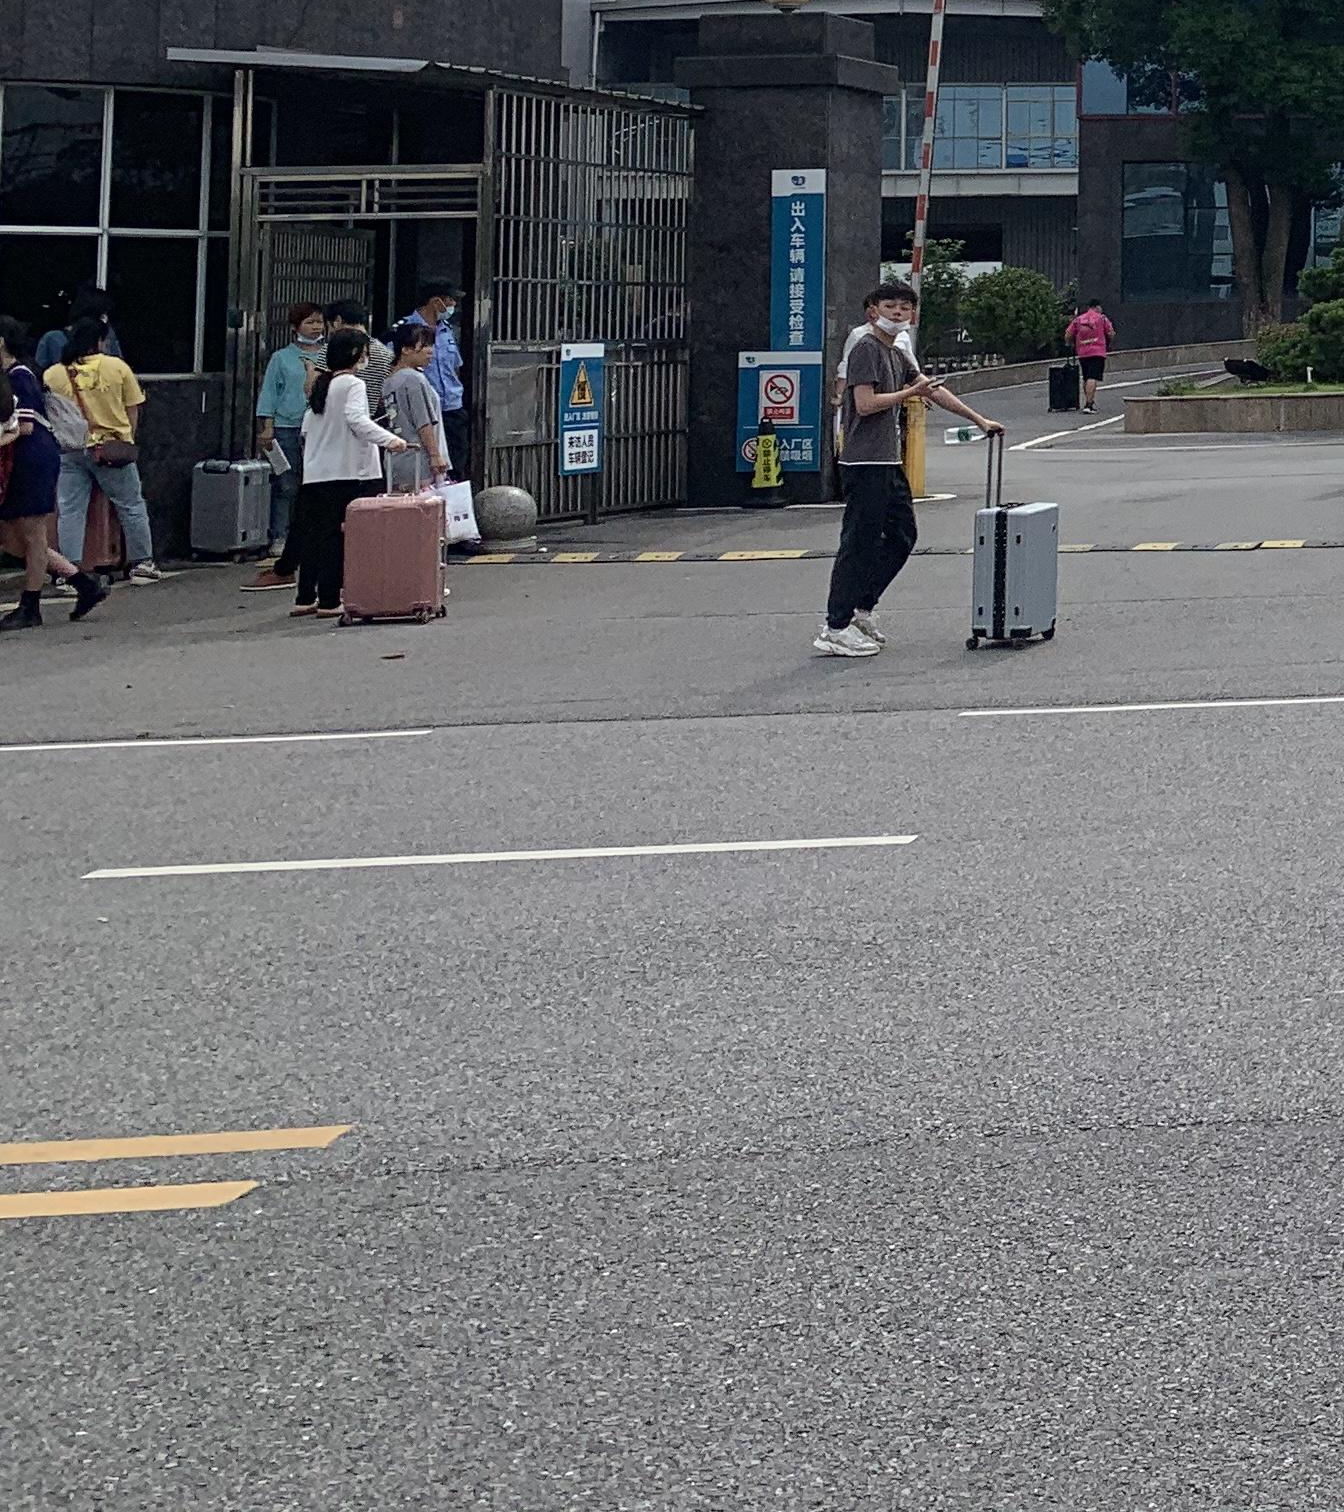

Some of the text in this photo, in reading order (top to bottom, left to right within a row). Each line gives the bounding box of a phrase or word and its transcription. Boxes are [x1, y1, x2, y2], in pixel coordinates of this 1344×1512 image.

[777, 438, 814, 450] 入厂区
[777, 449, 813, 462] 禁吸烟
